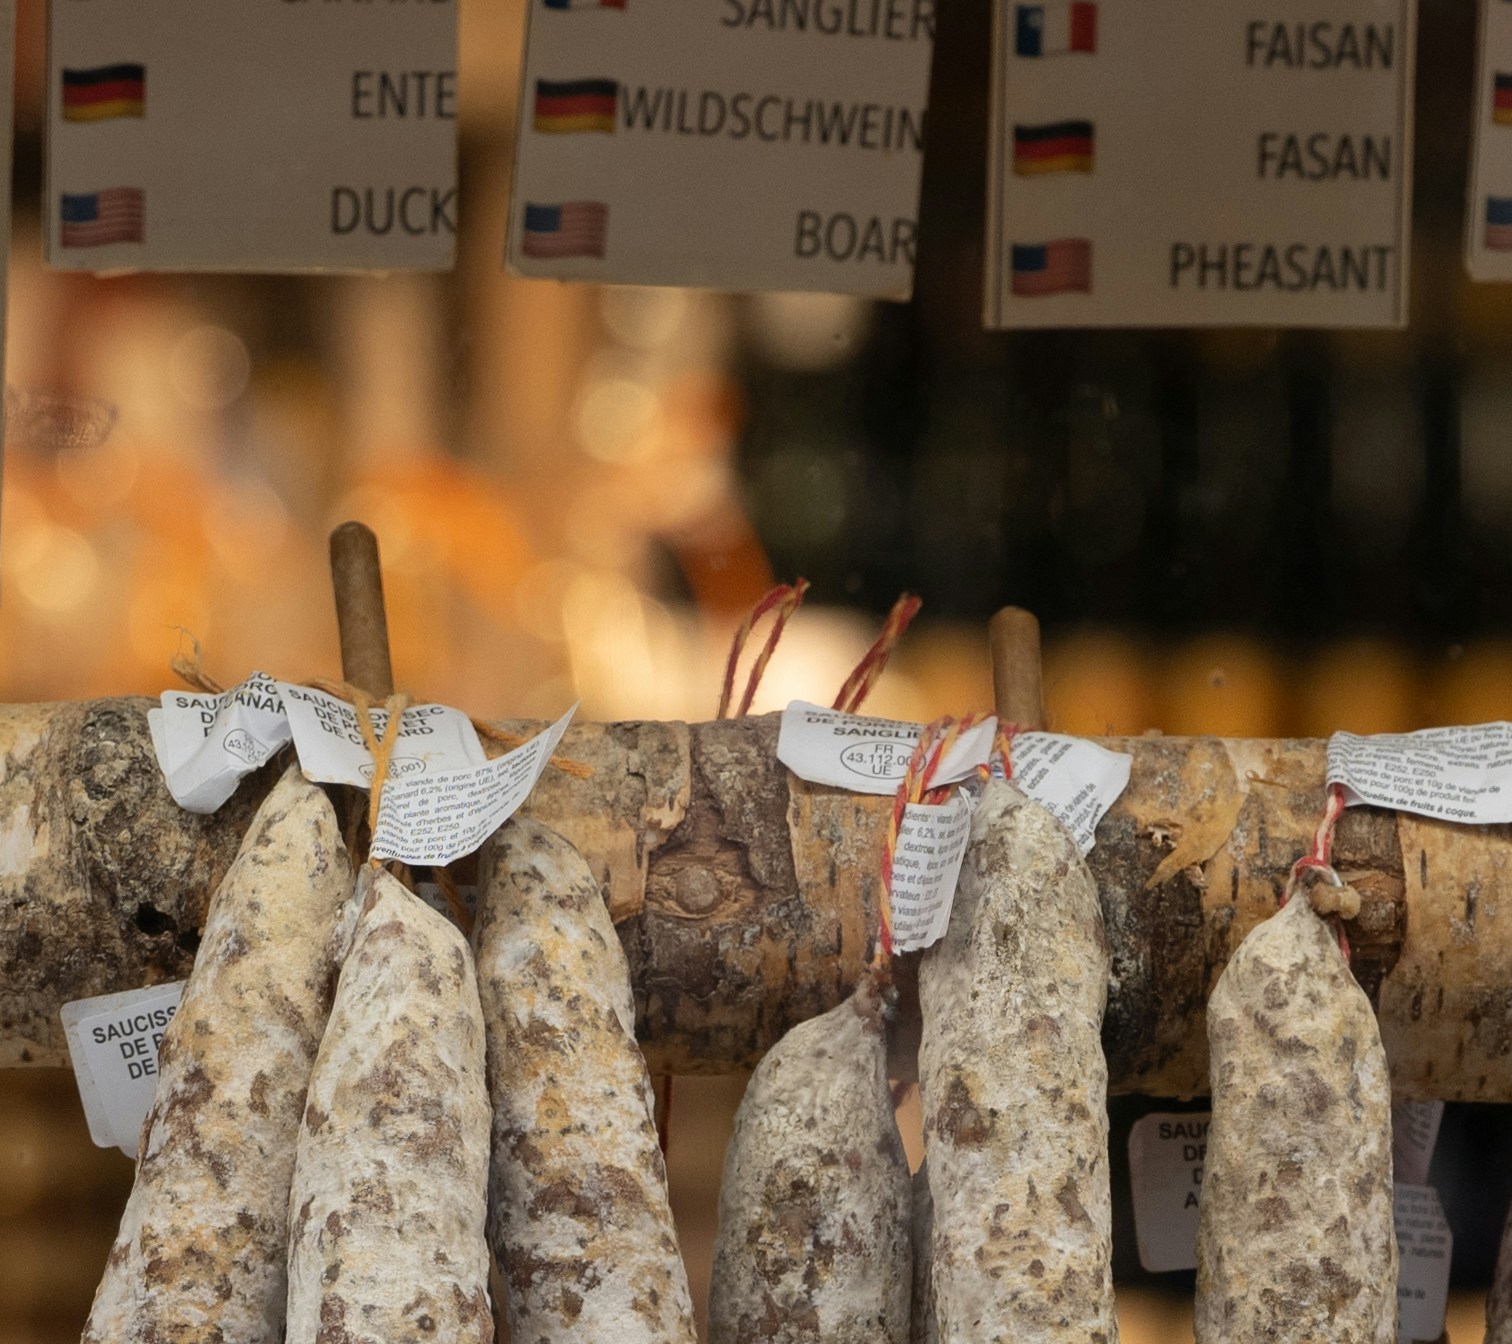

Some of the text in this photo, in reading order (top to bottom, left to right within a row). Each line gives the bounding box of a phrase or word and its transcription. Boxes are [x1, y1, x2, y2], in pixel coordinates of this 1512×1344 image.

[1245, 21, 1395, 71] FAISAN
[351, 70, 457, 120] ENTE
[621, 85, 926, 154] WILDSCHWEIN
[1257, 132, 1392, 182] FASAN
[329, 185, 458, 236] DUCK
[793, 208, 918, 265] BOAR
[1169, 242, 1396, 295] PHEASANT
[314, 706, 339, 726] DE
[402, 718, 428, 728] ET
[404, 706, 445, 719] SEC
[320, 720, 345, 740] DE
[833, 726, 923, 739] SANGLI
[846, 751, 913, 767] 43.112.00
[874, 743, 894, 754] FR
[871, 765, 892, 776] UE
[119, 1037, 150, 1060] DE
[127, 1057, 157, 1080] DE
